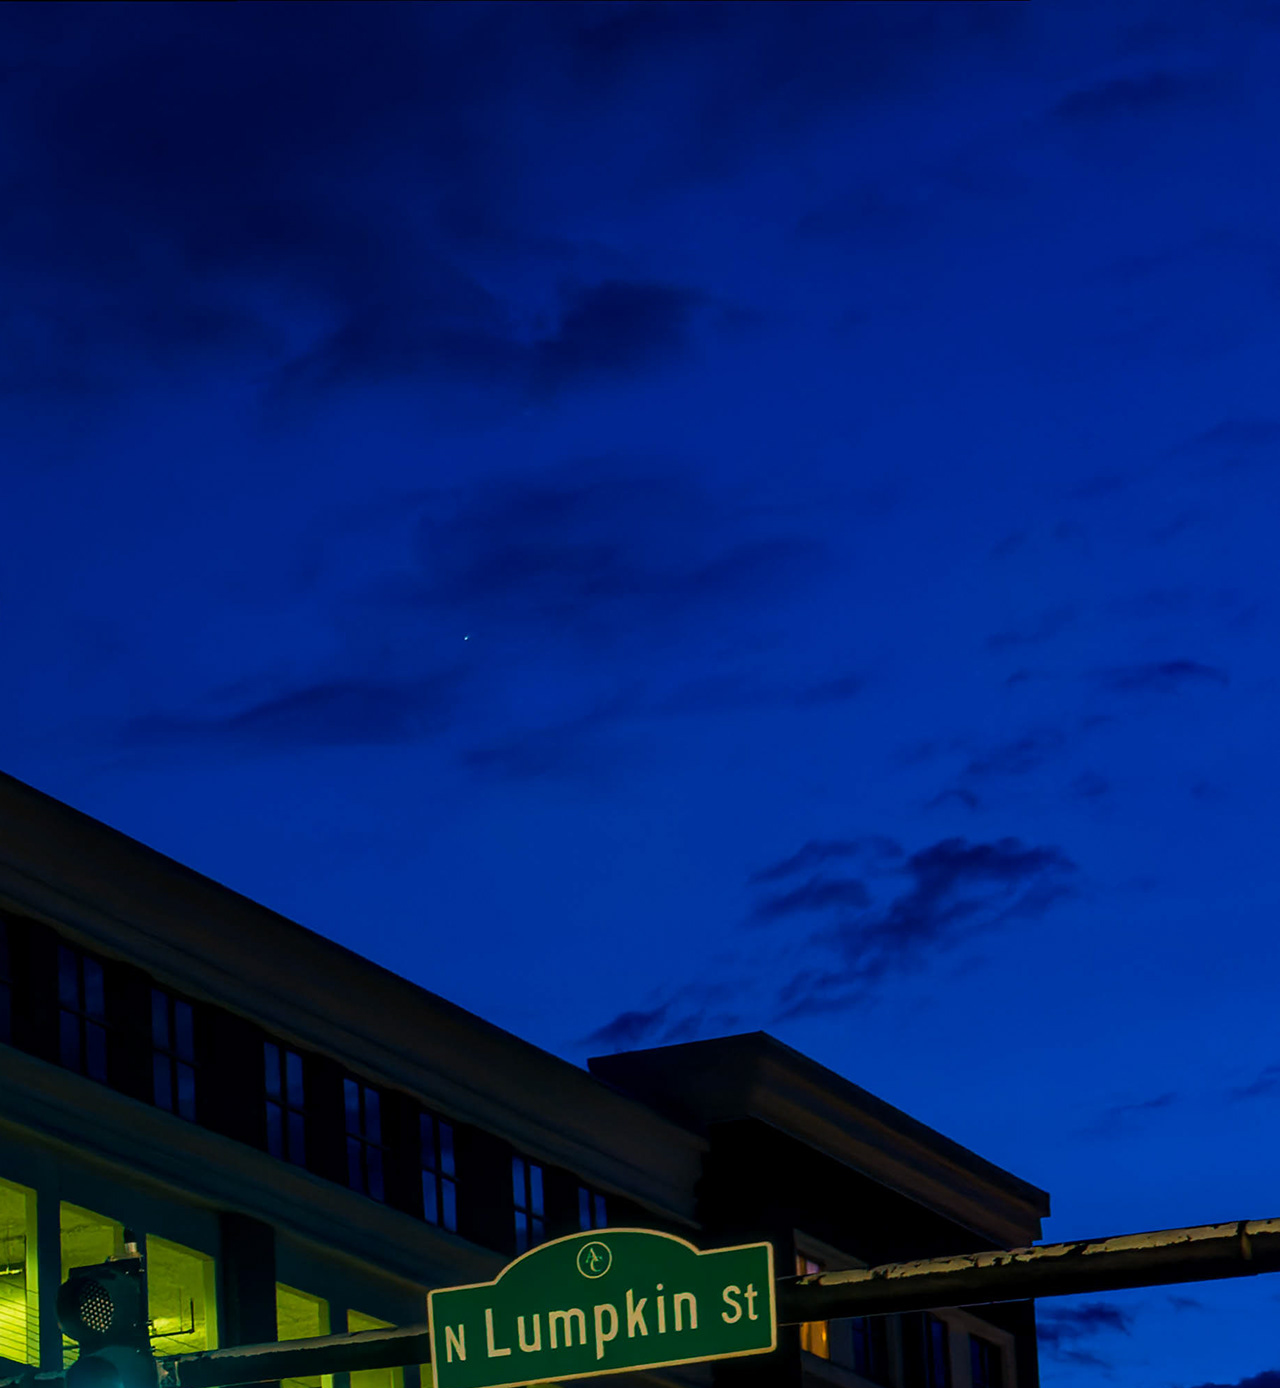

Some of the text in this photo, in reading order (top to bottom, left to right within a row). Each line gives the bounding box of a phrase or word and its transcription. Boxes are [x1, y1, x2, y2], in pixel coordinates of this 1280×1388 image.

[445, 1284, 758, 1363] N Lumpkin St
